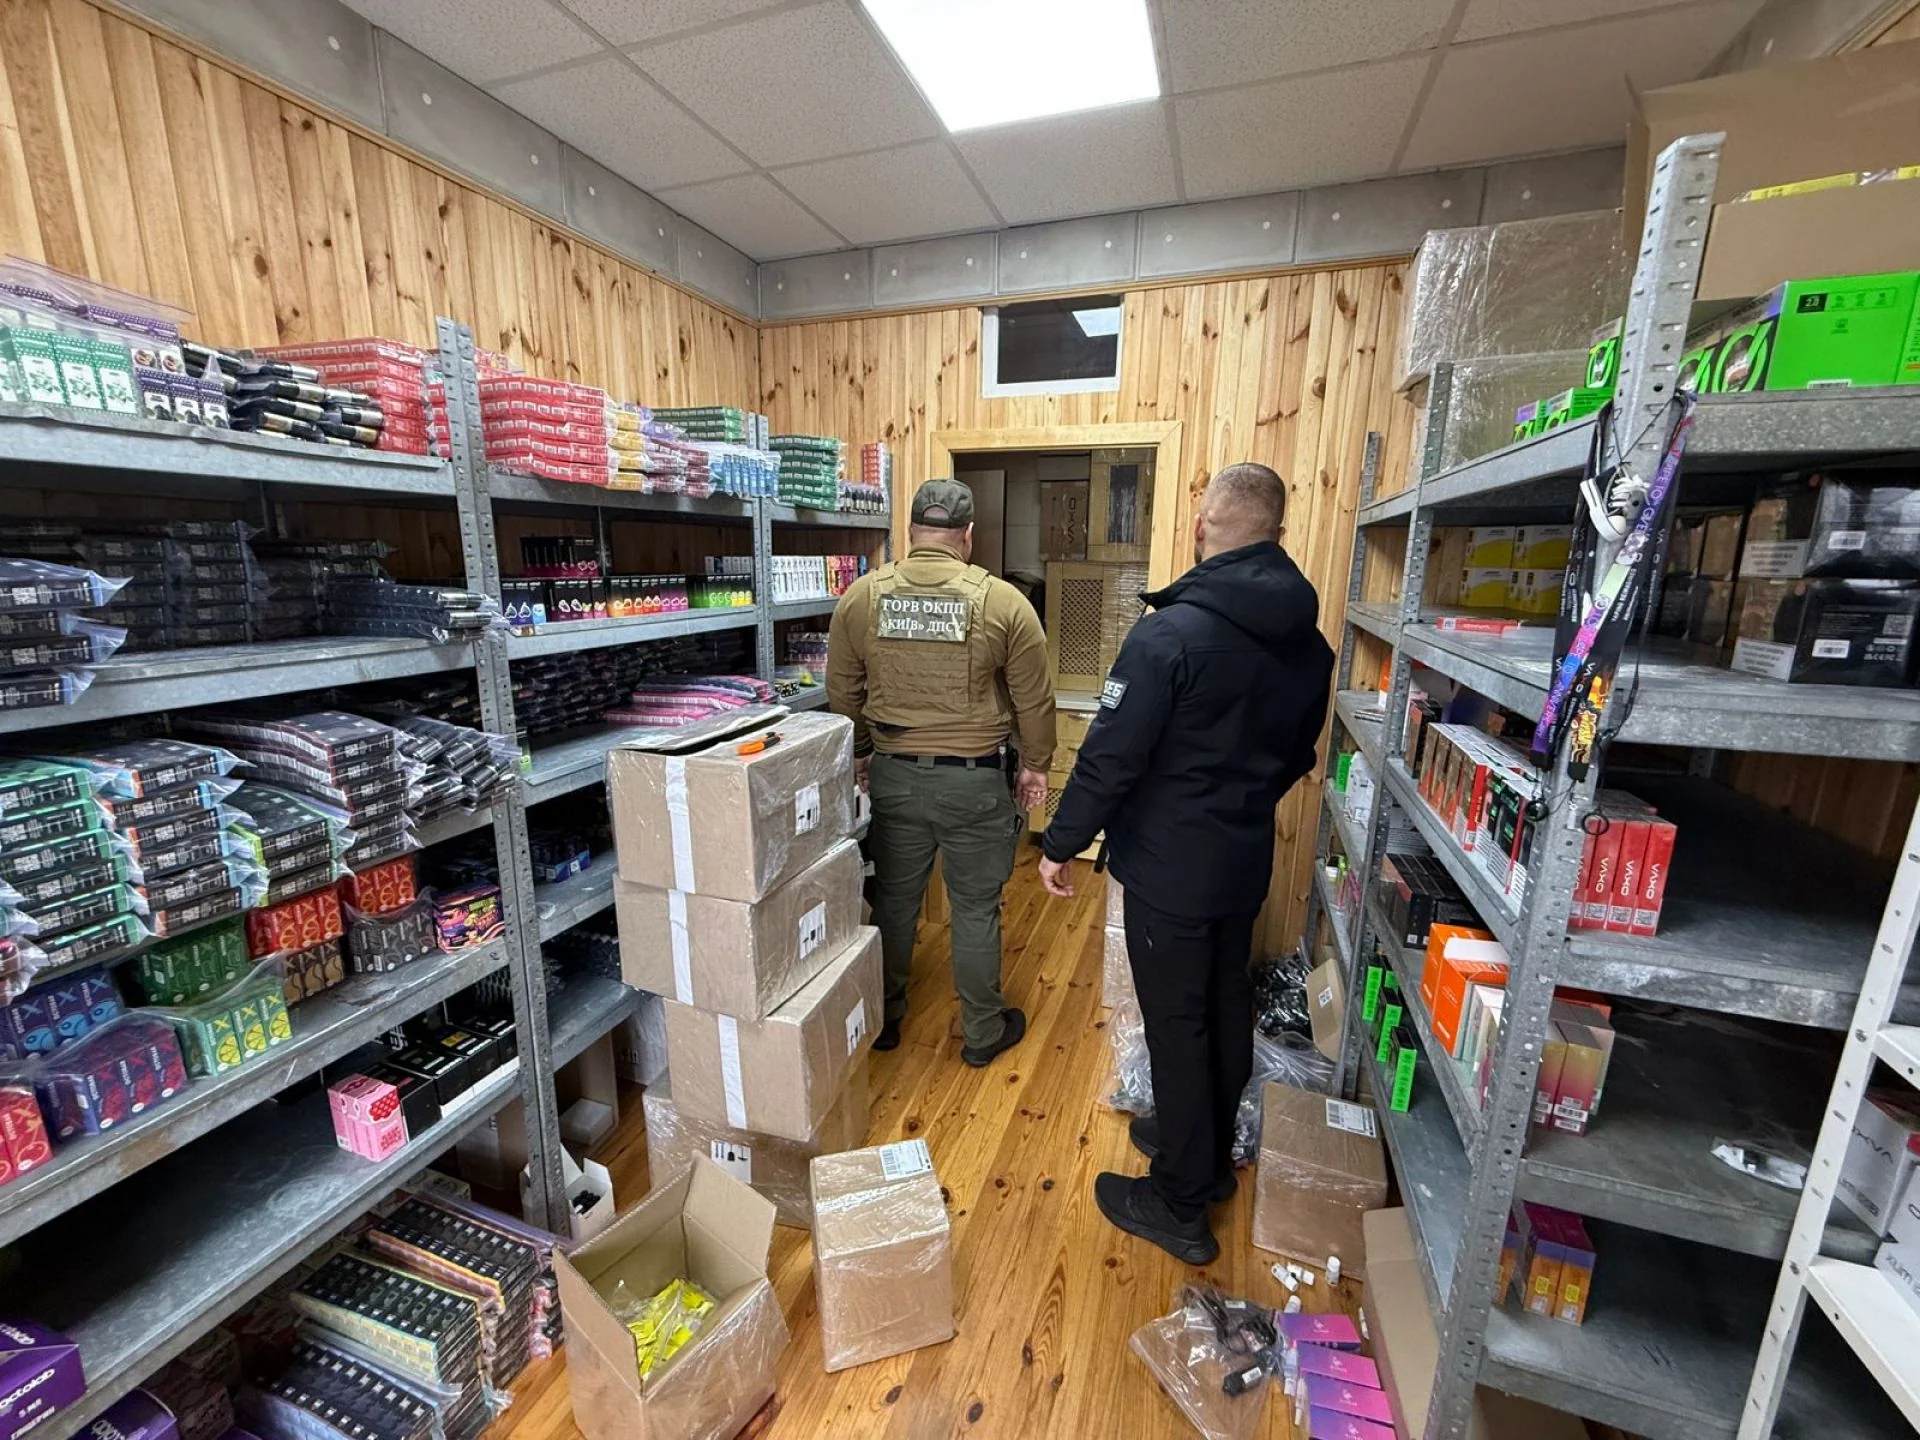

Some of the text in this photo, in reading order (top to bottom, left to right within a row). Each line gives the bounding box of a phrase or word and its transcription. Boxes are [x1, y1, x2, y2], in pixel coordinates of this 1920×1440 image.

[883, 599, 965, 614] ГОРВ ОКПП
[881, 617, 966, 633] «КИЇВ» ДПСУ
[1620, 860, 1635, 896] OXVA
[1645, 863, 1660, 900] OXVA
